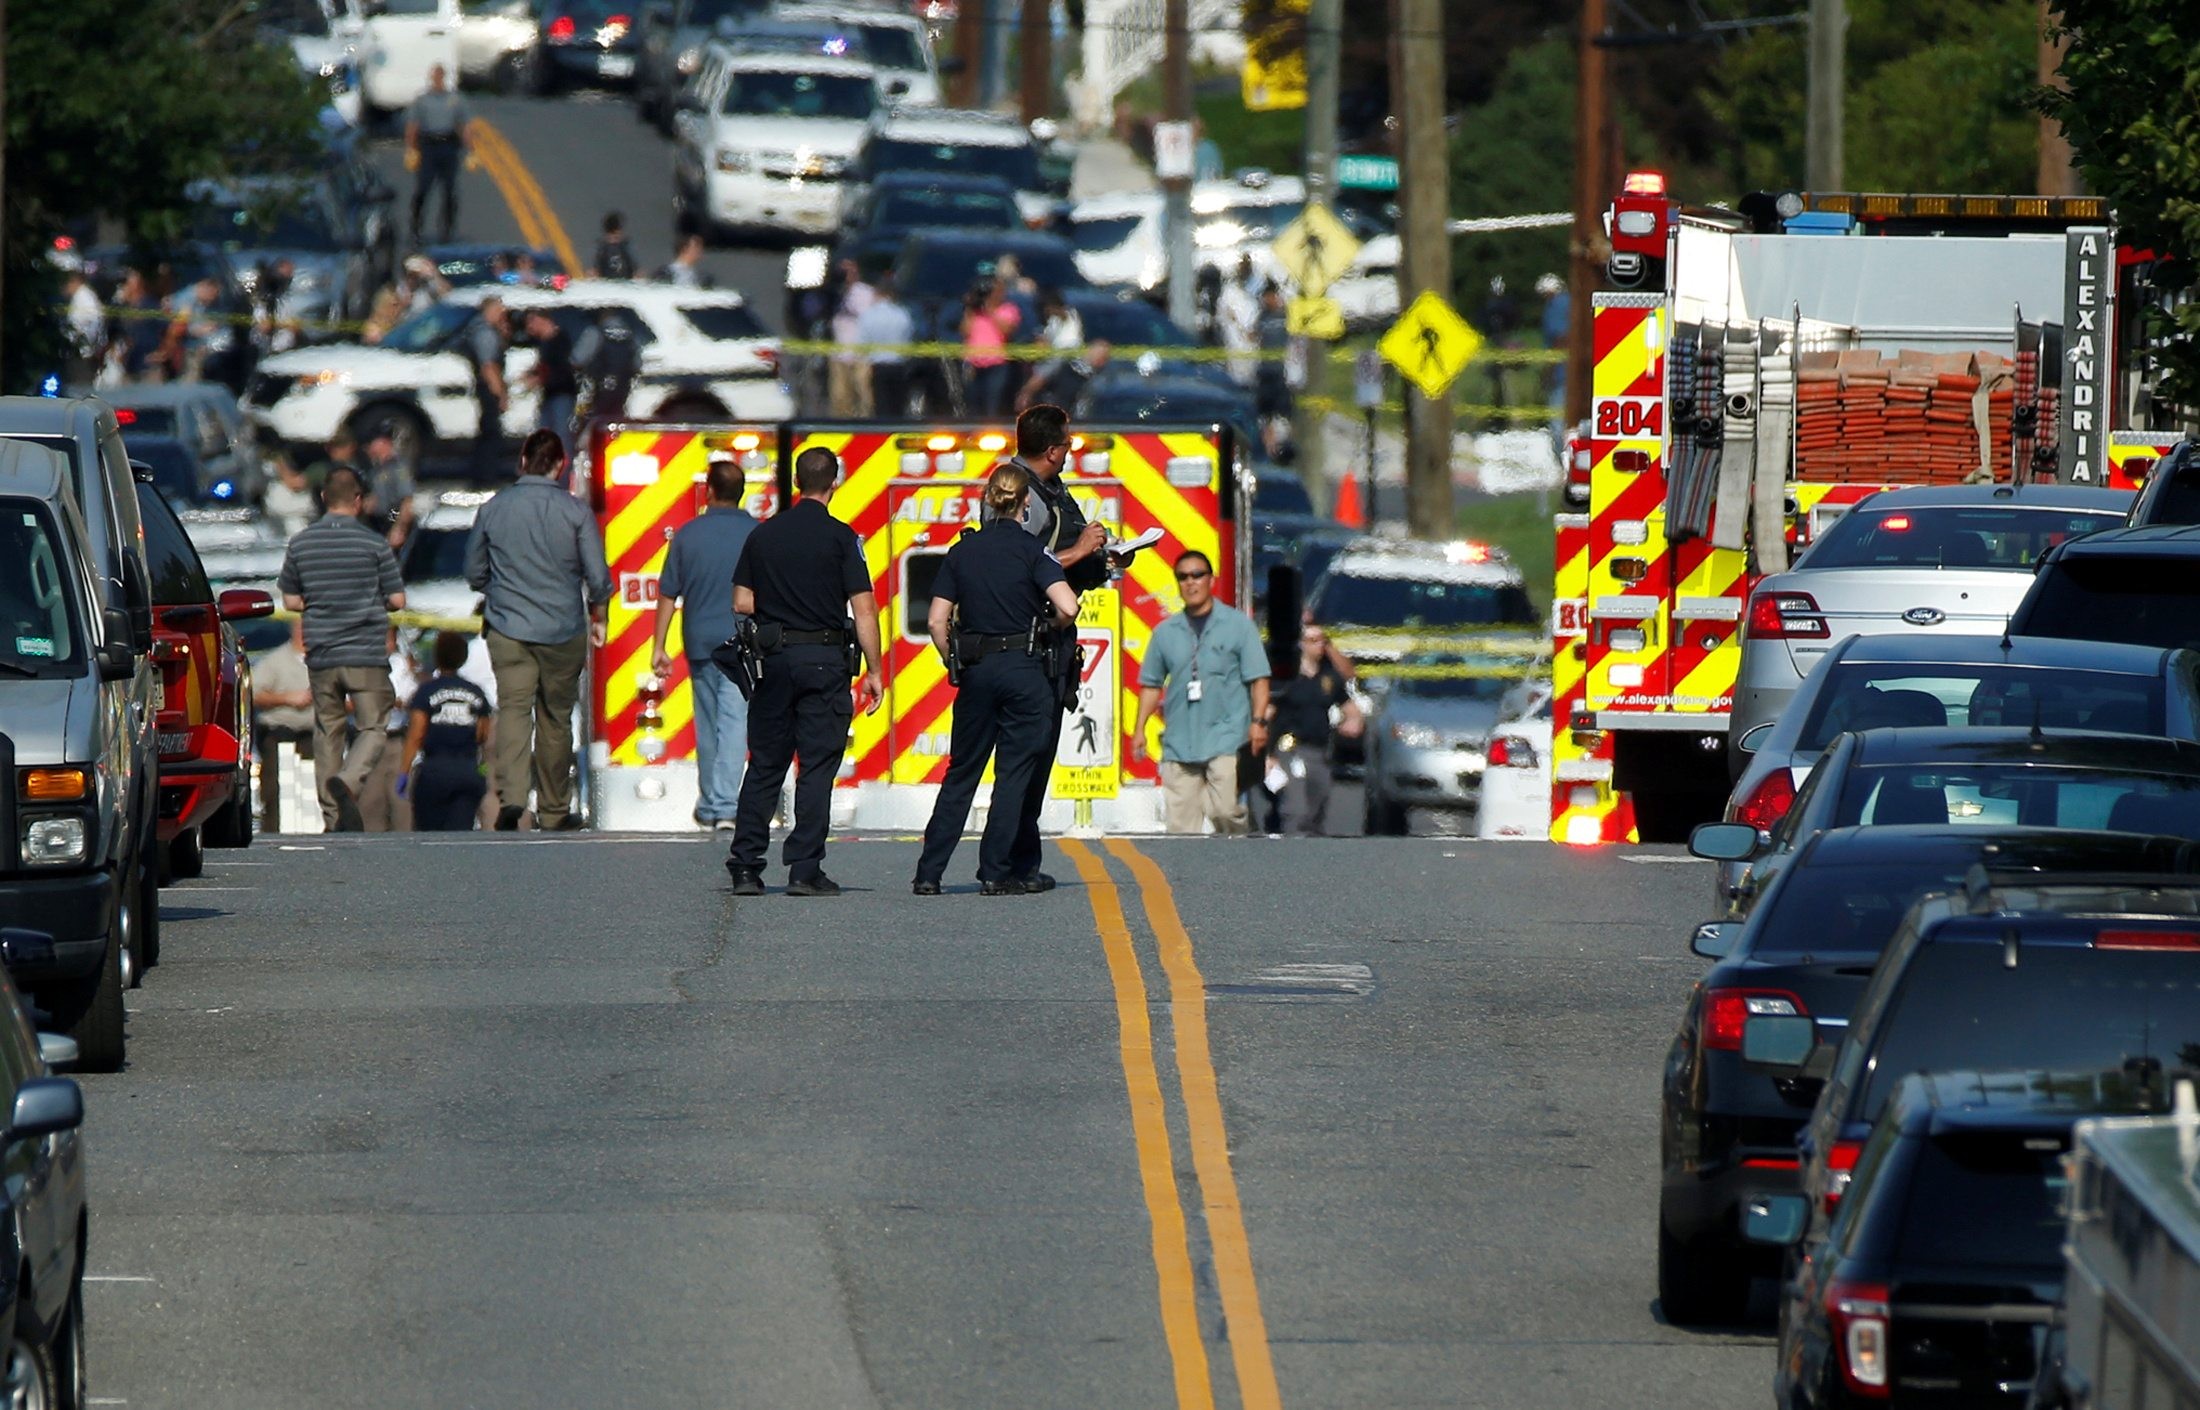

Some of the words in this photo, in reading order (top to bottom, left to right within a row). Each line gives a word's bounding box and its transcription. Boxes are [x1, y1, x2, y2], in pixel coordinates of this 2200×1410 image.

[2072, 235, 2098, 481] ALEXANDRIA
[1597, 401, 1662, 436] 204
[627, 579, 660, 603] 20
[1080, 594, 1105, 607] ATE
[1078, 610, 1100, 623] AW
[1069, 770, 1102, 780] WITHIN
[1056, 783, 1114, 793] CROSSWALK
